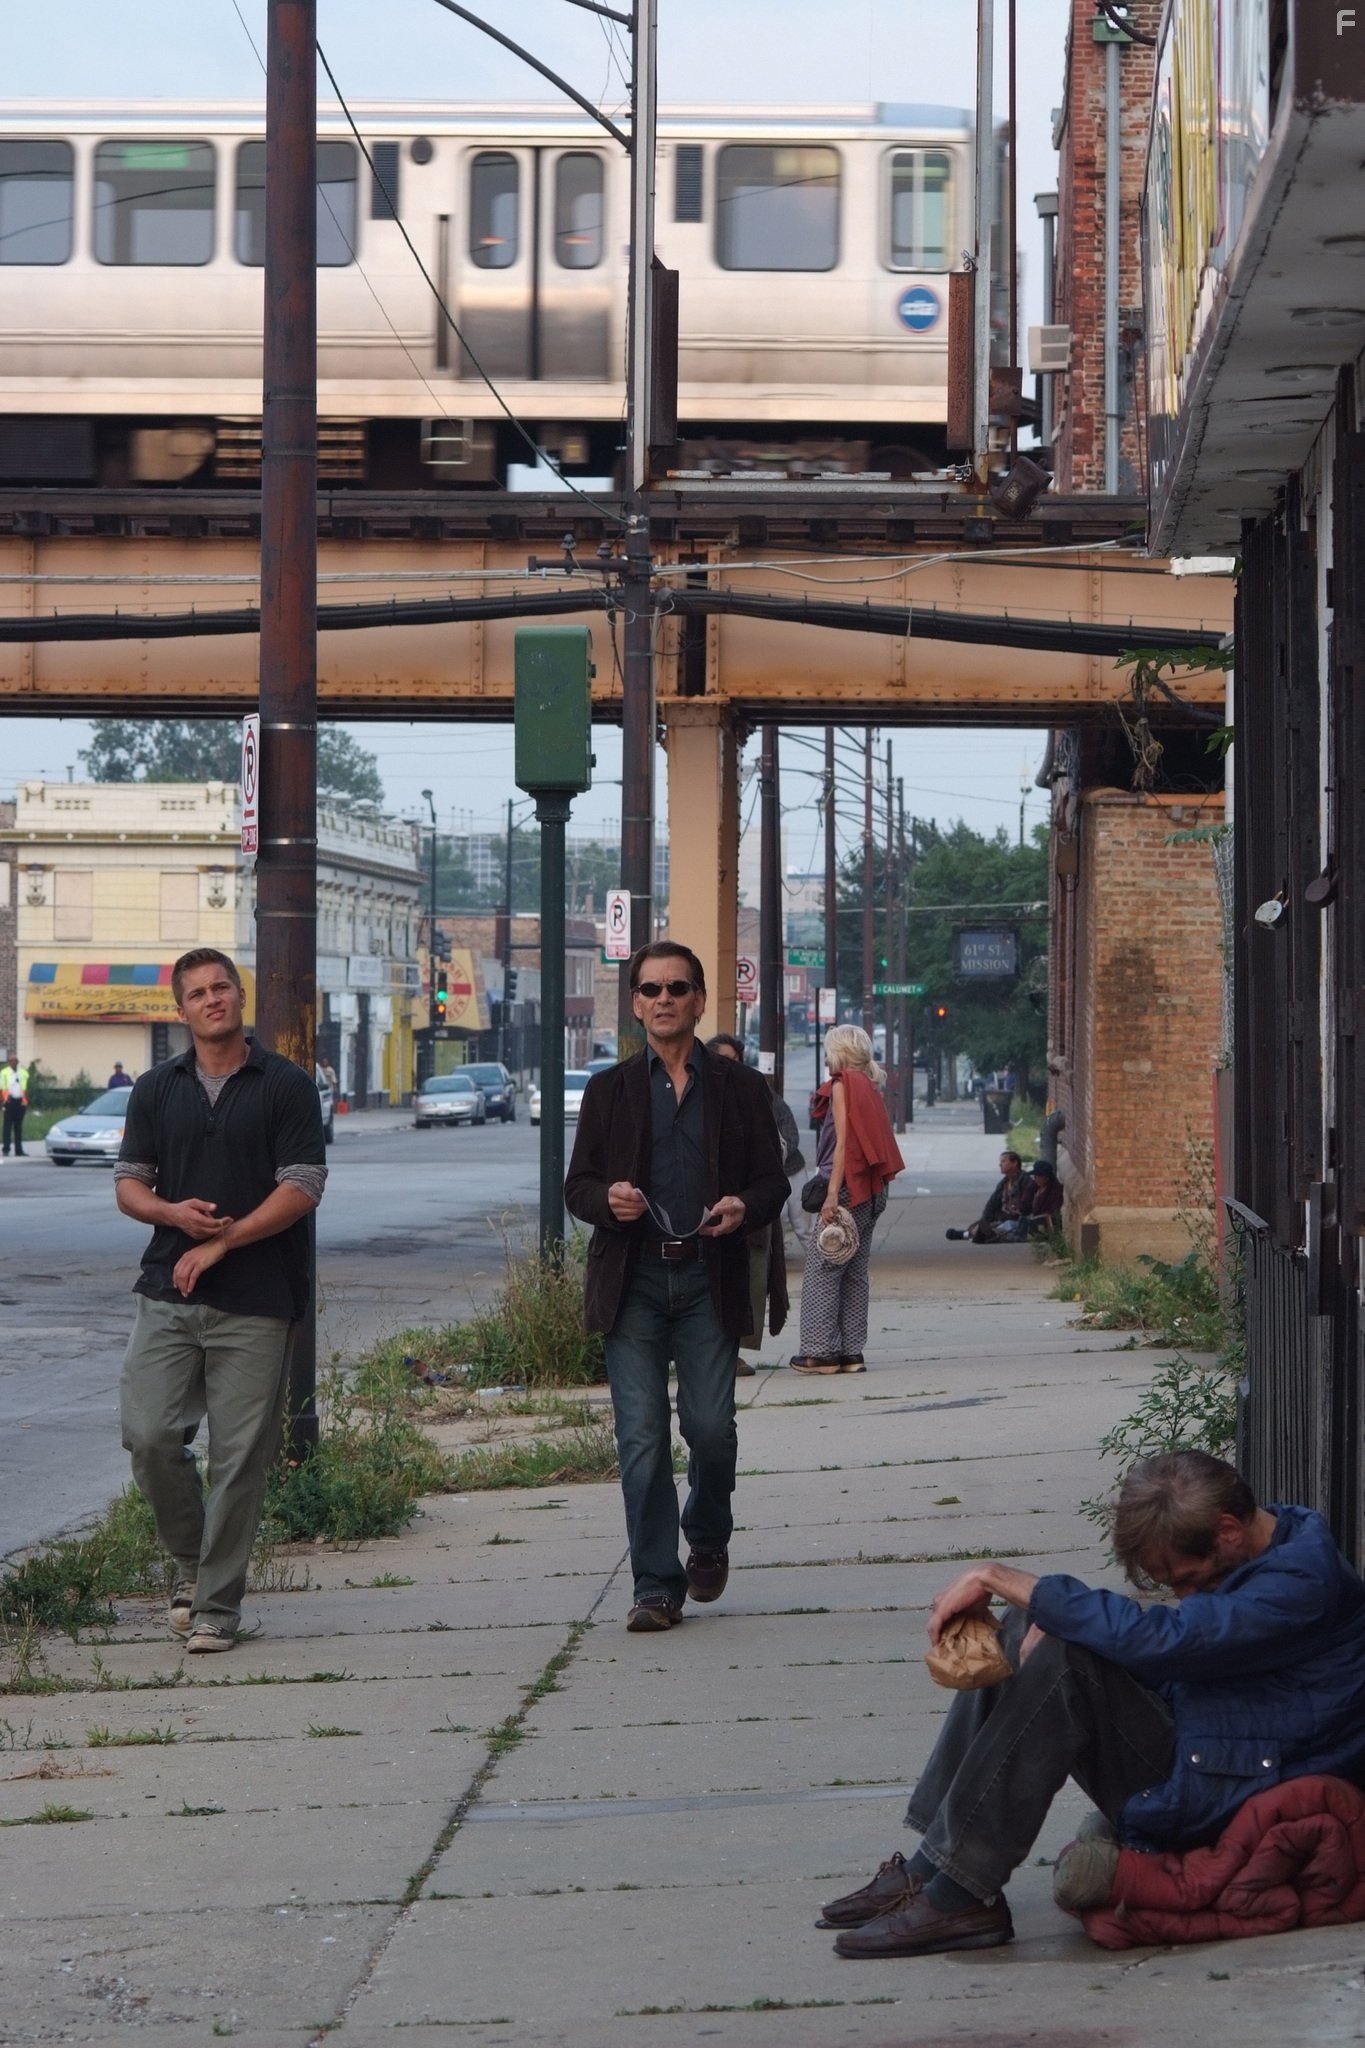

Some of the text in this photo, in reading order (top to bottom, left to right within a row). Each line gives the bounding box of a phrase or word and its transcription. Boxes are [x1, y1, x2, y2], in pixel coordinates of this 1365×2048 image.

[961, 960, 1009, 970] MISSION
[883, 984, 916, 994] CALUMET
[40, 1001, 68, 1010] TEL.
